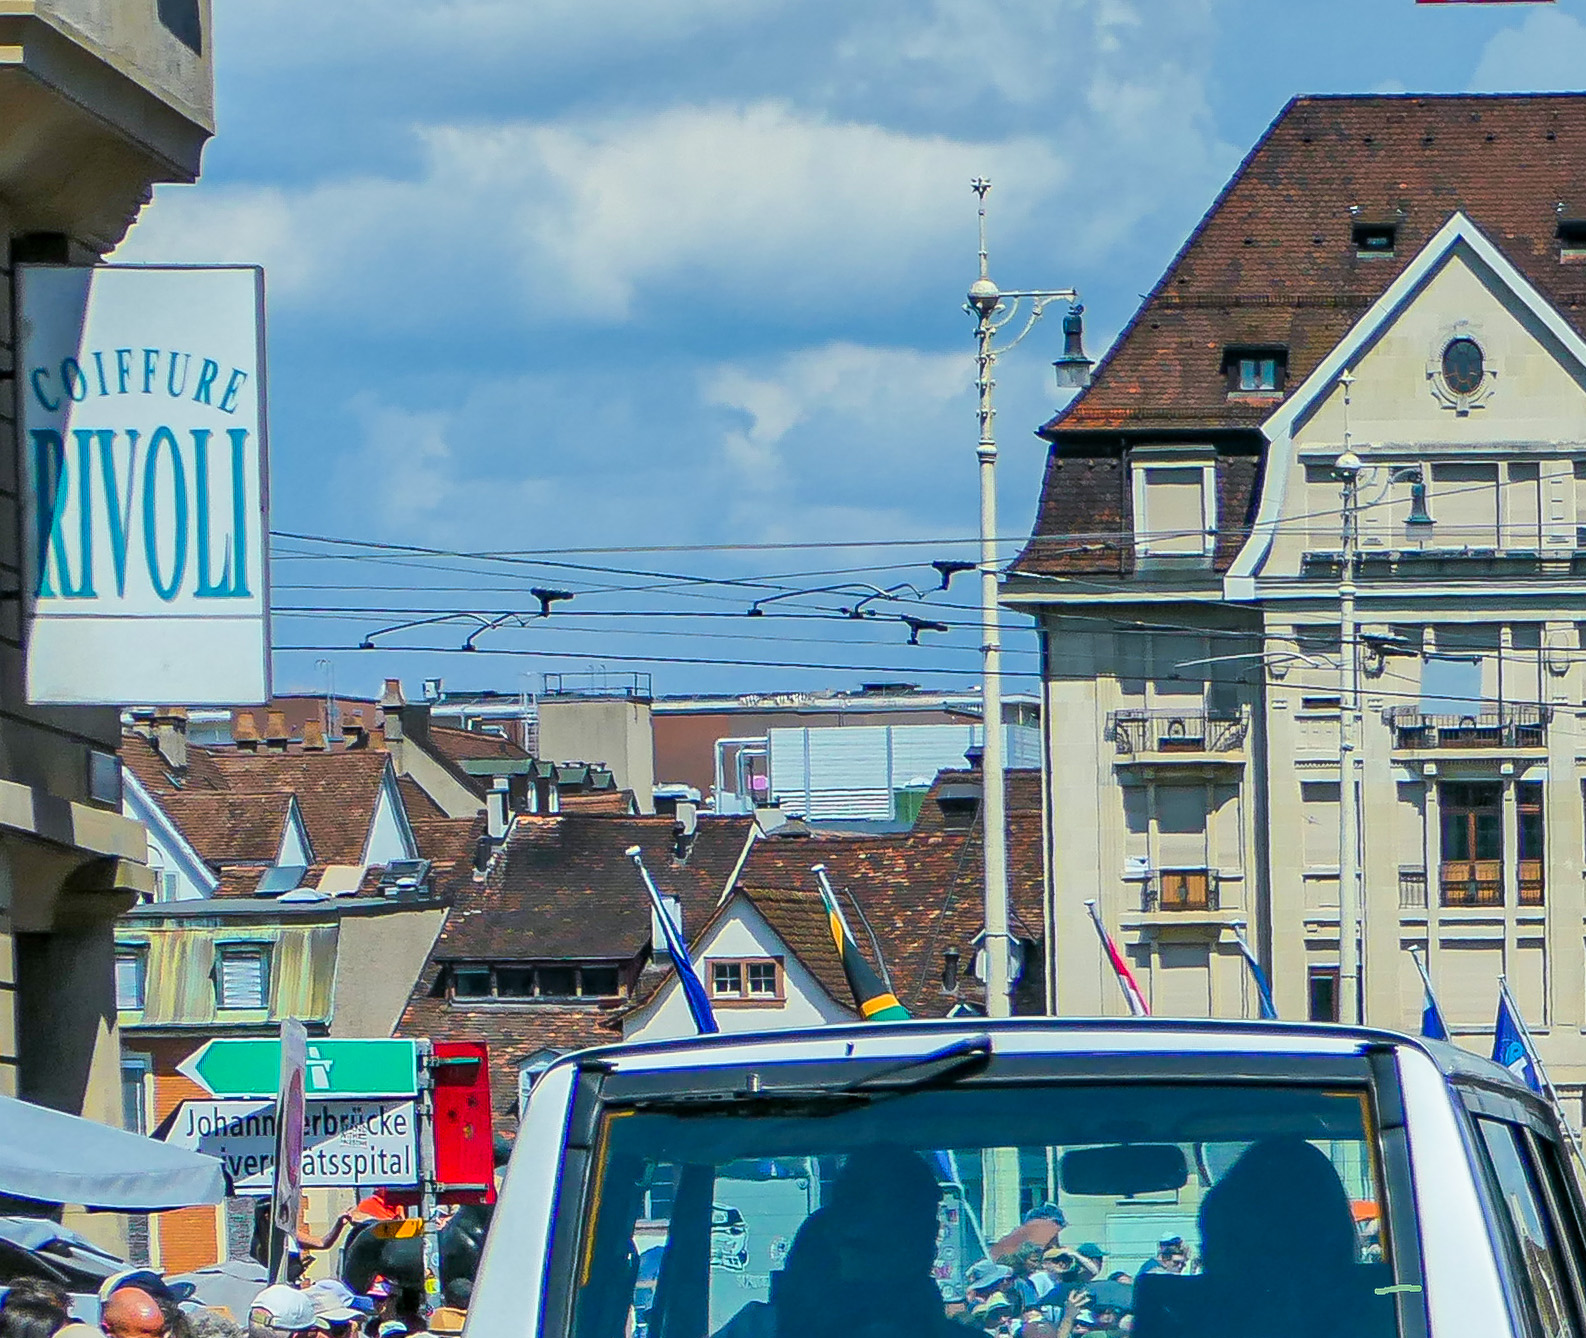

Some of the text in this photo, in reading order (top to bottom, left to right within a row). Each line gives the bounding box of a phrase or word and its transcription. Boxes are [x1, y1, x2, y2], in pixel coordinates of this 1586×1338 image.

[30, 348, 248, 415] COIFFURE
[29, 425, 254, 603] RIVOLI
[185, 1106, 408, 1138] Johannerbrücke
